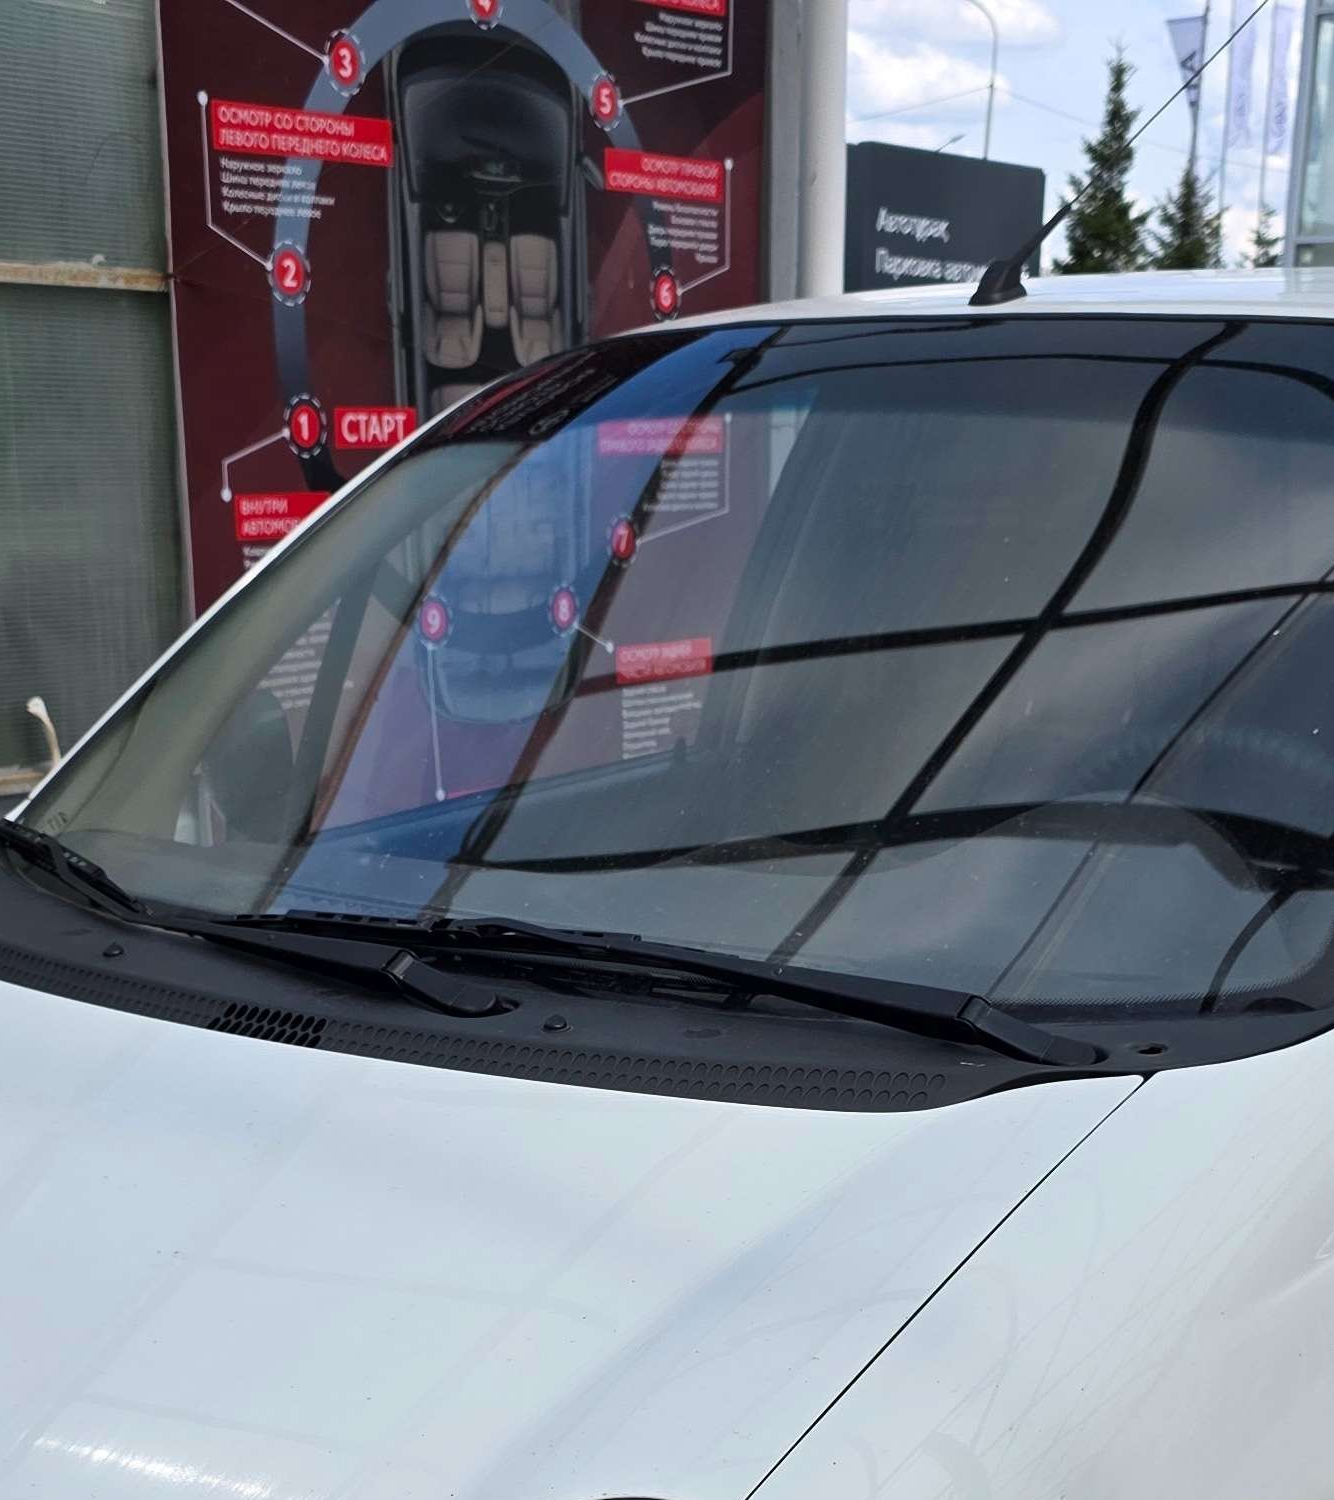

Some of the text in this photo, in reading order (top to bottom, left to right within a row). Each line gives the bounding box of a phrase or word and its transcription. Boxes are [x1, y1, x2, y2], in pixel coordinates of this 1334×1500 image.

[339, 48, 352, 77] 3
[600, 87, 612, 114] 5
[219, 106, 354, 137] ОСМОТР СО СТОРОНЫ
[220, 129, 387, 162] ЛЕВОГО ПЕРЕДНЕГО КОЛЕСА
[282, 259, 298, 287] 2
[660, 283, 672, 308] 6
[298, 414, 309, 441] 1
[341, 412, 407, 443] СТАРТ
[241, 500, 288, 516] ВНУТРИ
[241, 518, 301, 537] АВТОМО
[618, 528, 629, 553] 7
[426, 609, 440, 634] 9
[559, 598, 569, 622] 8
